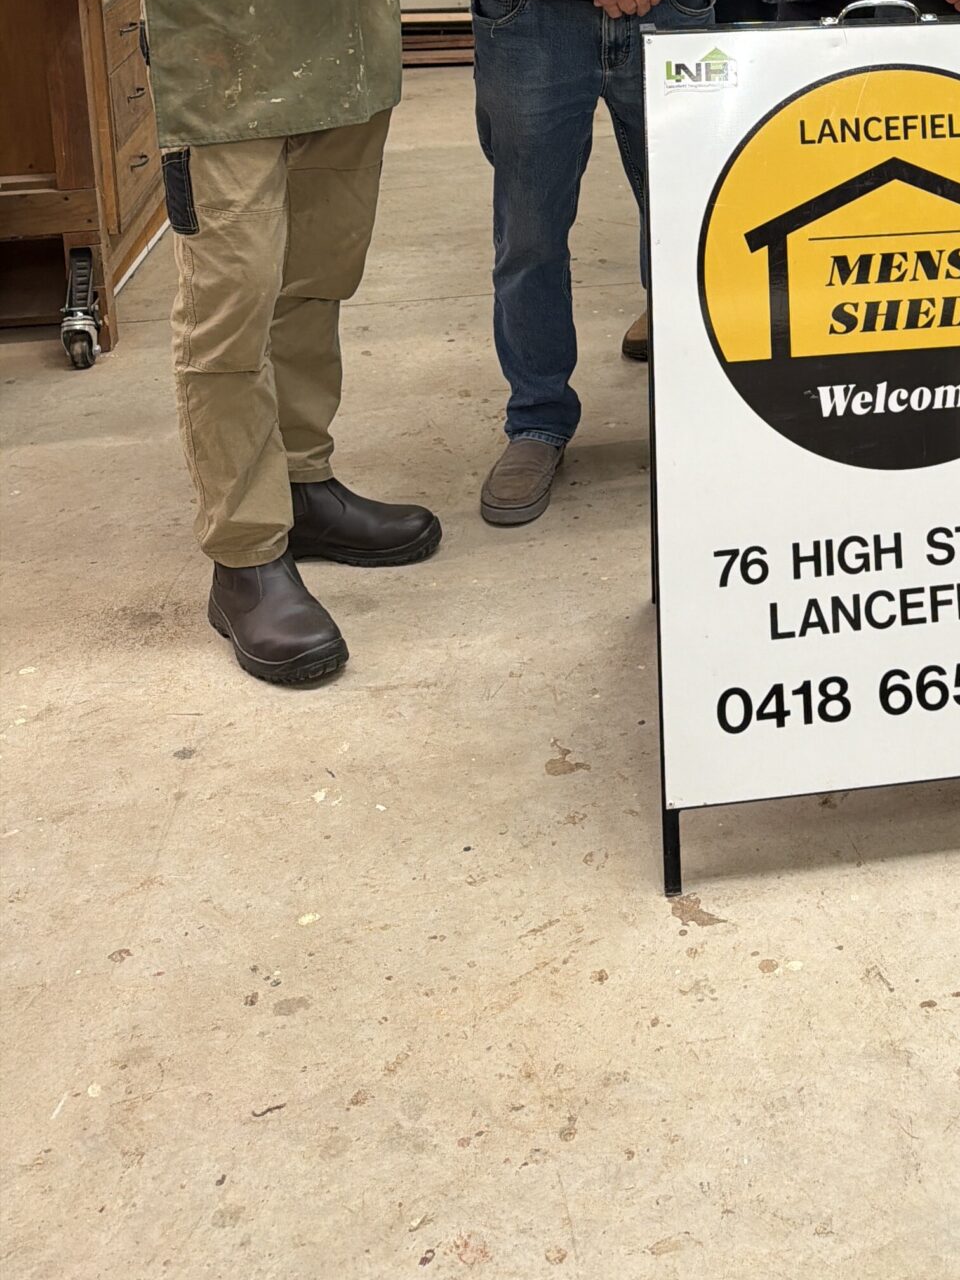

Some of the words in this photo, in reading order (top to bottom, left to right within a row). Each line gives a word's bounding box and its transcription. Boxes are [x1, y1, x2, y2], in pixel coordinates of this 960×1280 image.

[713, 545, 769, 588] 76
[792, 532, 903, 580] HIGH
[716, 676, 852, 734] 0418
